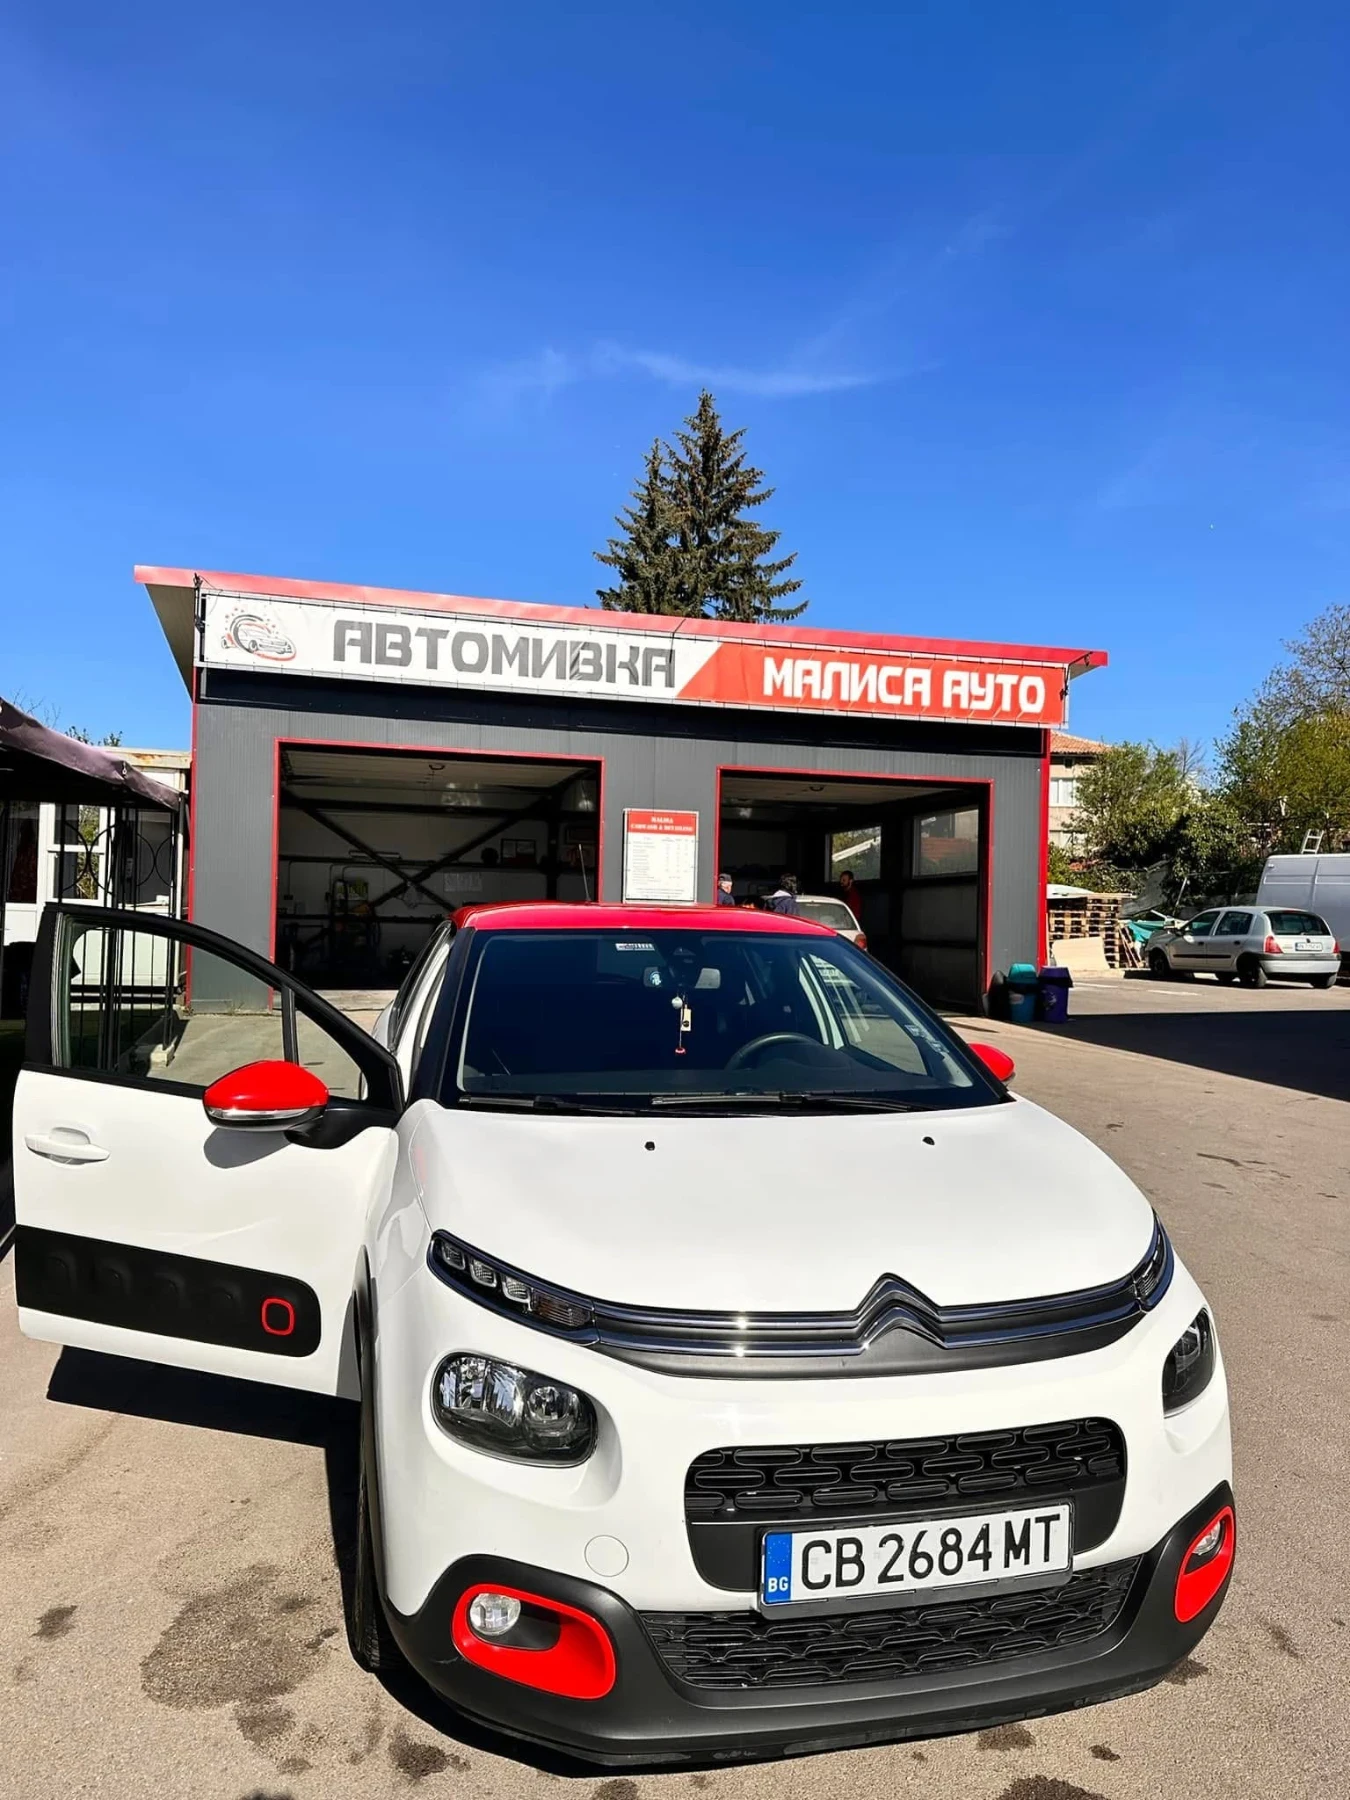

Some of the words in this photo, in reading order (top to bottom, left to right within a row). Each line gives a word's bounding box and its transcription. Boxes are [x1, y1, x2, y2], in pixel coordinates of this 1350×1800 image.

[333, 619, 676, 688] АВТОМИВКА
[763, 656, 933, 707] МАЛИСА
[942, 669, 1046, 713] АУТО
[801, 1537, 866, 1590] CB
[877, 1523, 992, 1585] 2684
[1003, 1514, 1061, 1569] MT
[768, 1577, 789, 1593] BG
